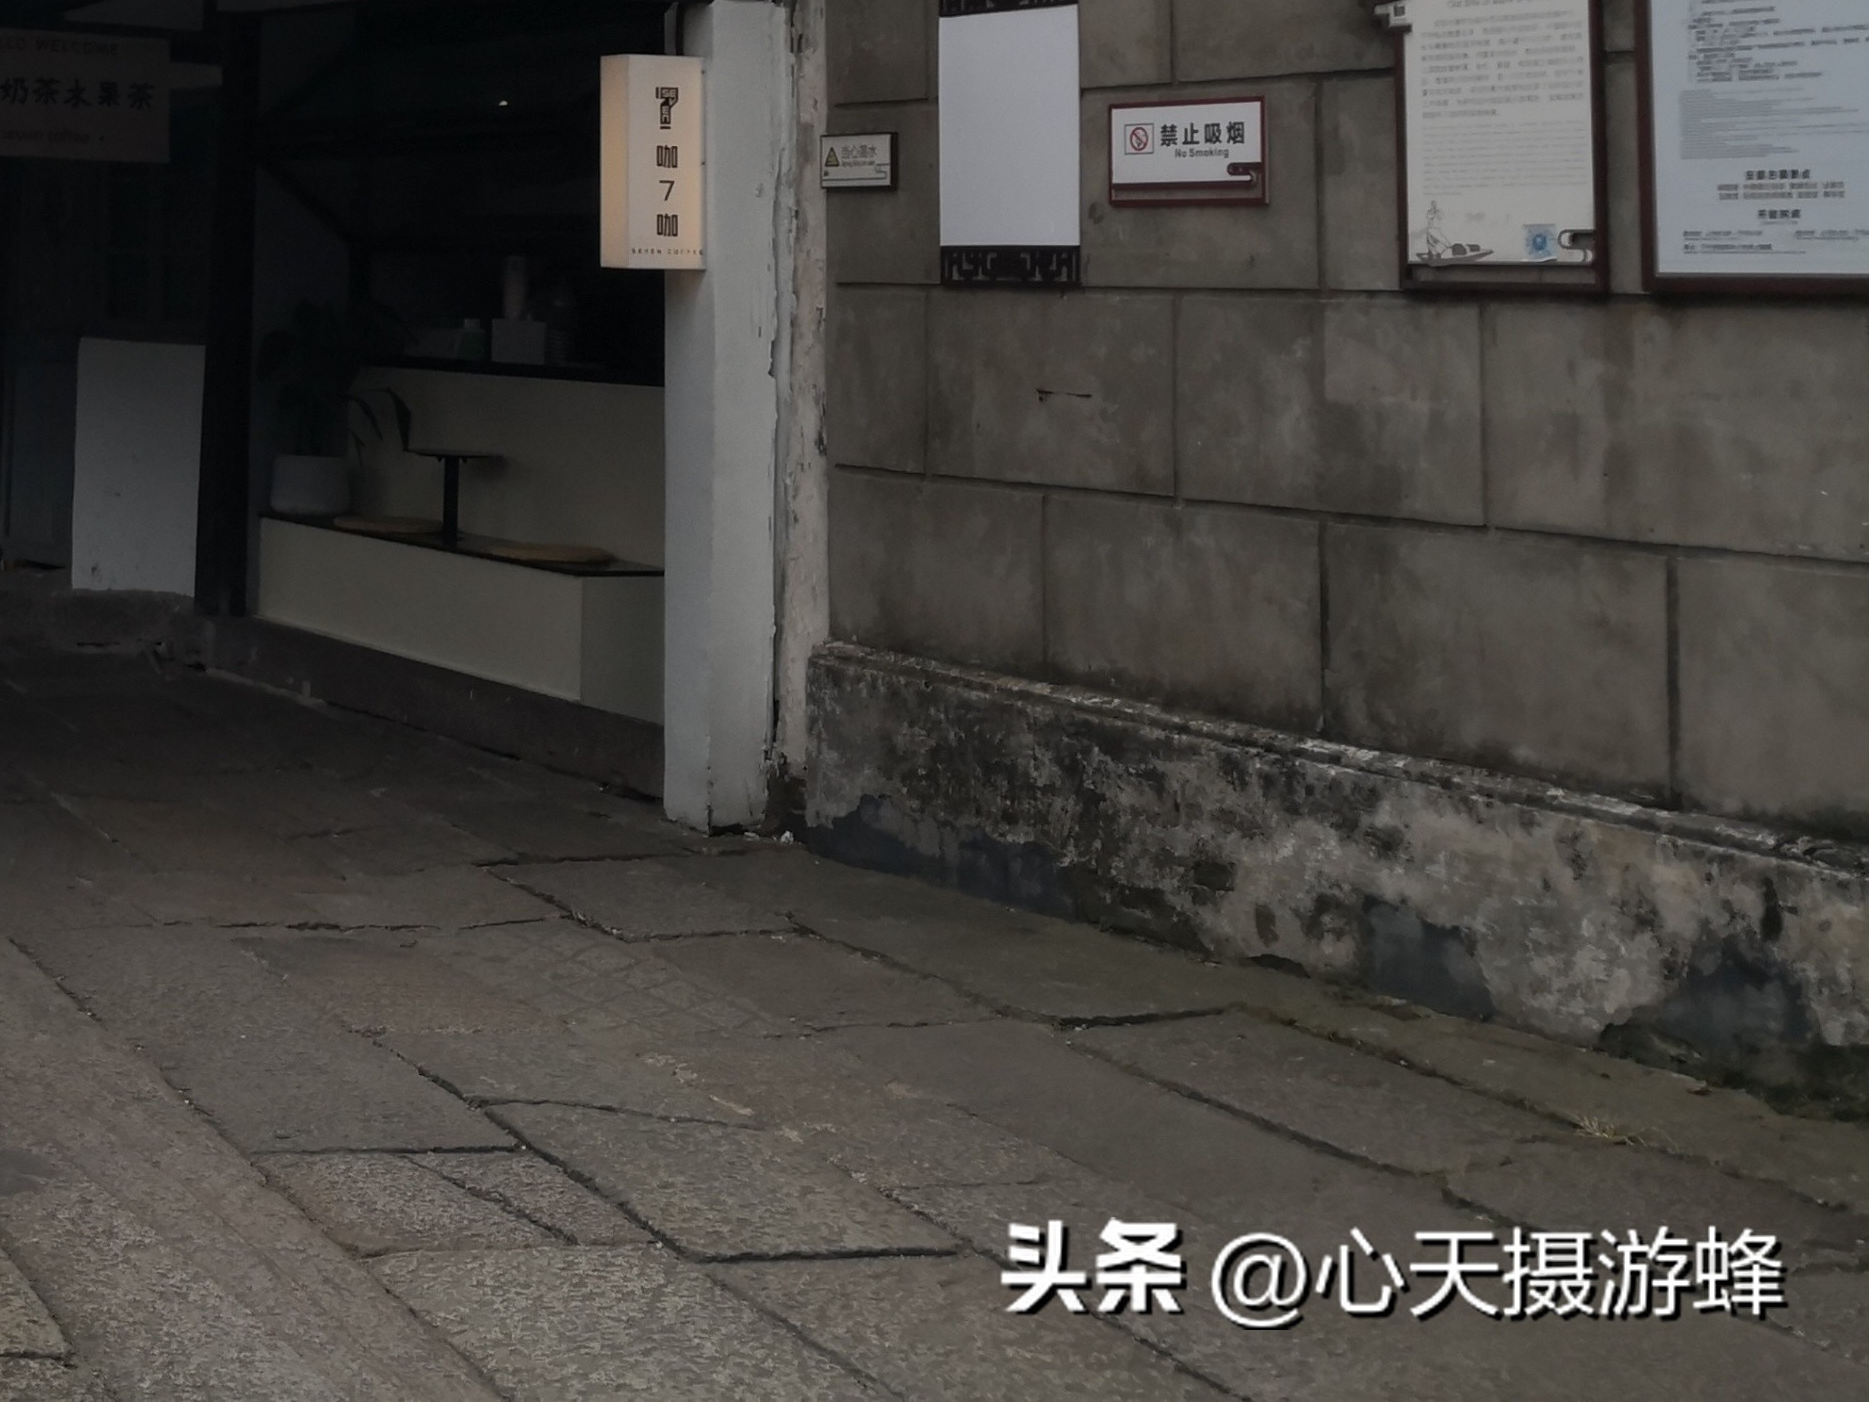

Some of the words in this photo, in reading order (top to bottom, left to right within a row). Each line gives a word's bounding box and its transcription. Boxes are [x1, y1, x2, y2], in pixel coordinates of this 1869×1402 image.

[35, 37, 120, 55] WELCOME
[1160, 121, 1245, 147] 禁止吸烟
[1174, 149, 1187, 158] No
[1189, 147, 1229, 159] Smoking
